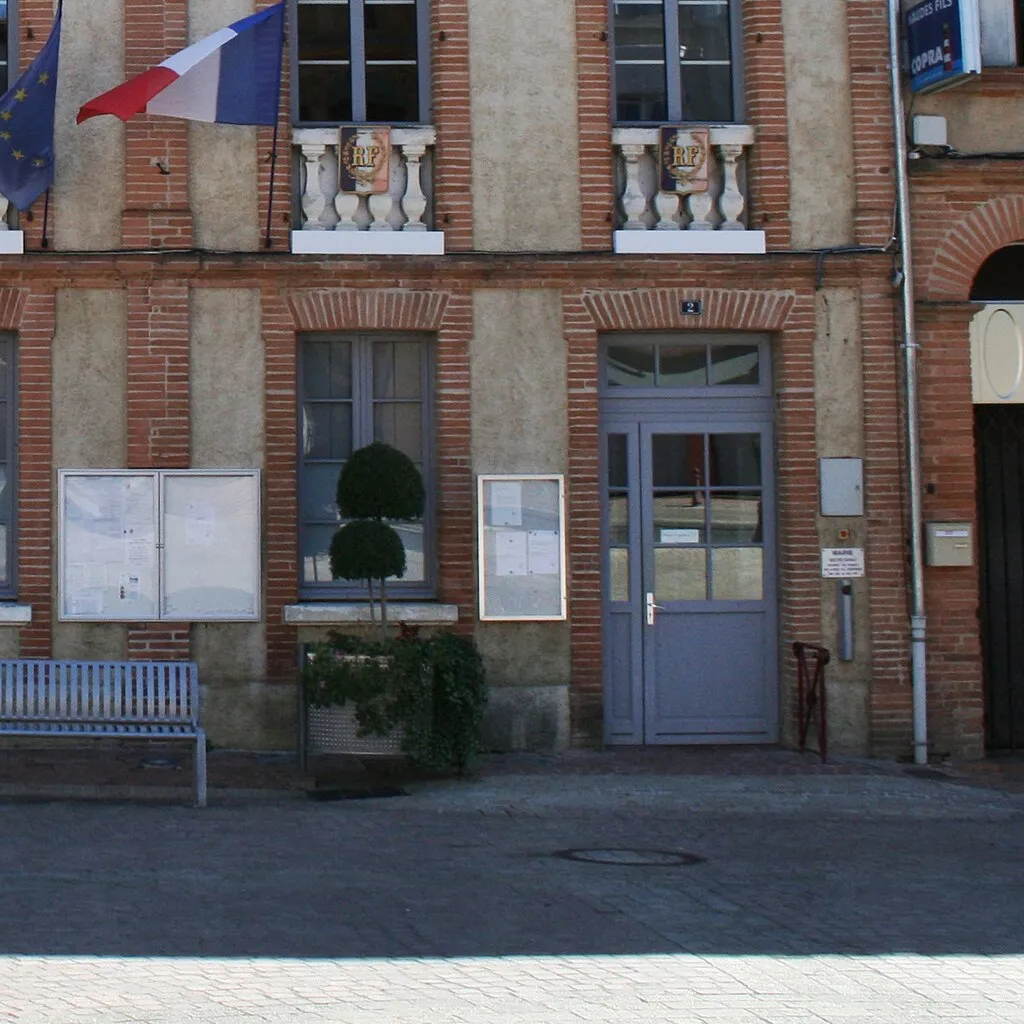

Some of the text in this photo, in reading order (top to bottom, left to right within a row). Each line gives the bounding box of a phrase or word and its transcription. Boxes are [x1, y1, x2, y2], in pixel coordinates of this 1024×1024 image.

[911, 46, 944, 75] COPRA
[351, 145, 380, 167] RF
[671, 145, 699, 167] RF
[687, 302, 695, 313] 2
